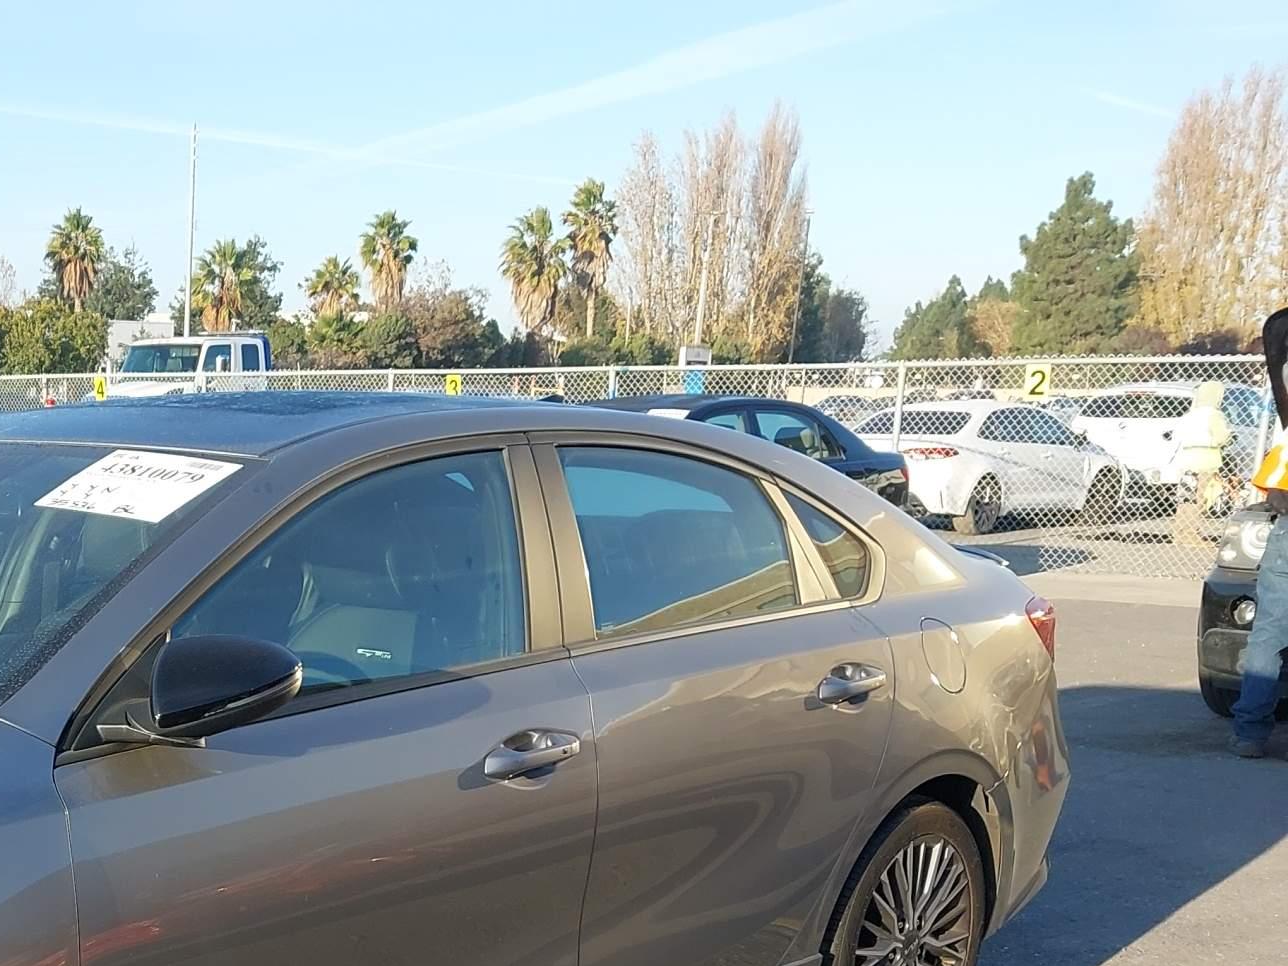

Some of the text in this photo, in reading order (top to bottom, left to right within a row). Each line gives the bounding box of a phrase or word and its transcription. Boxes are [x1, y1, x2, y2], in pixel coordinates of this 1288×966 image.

[96, 380, 104, 398] 4
[1028, 370, 1046, 395] 2
[101, 462, 205, 484] 43810079
